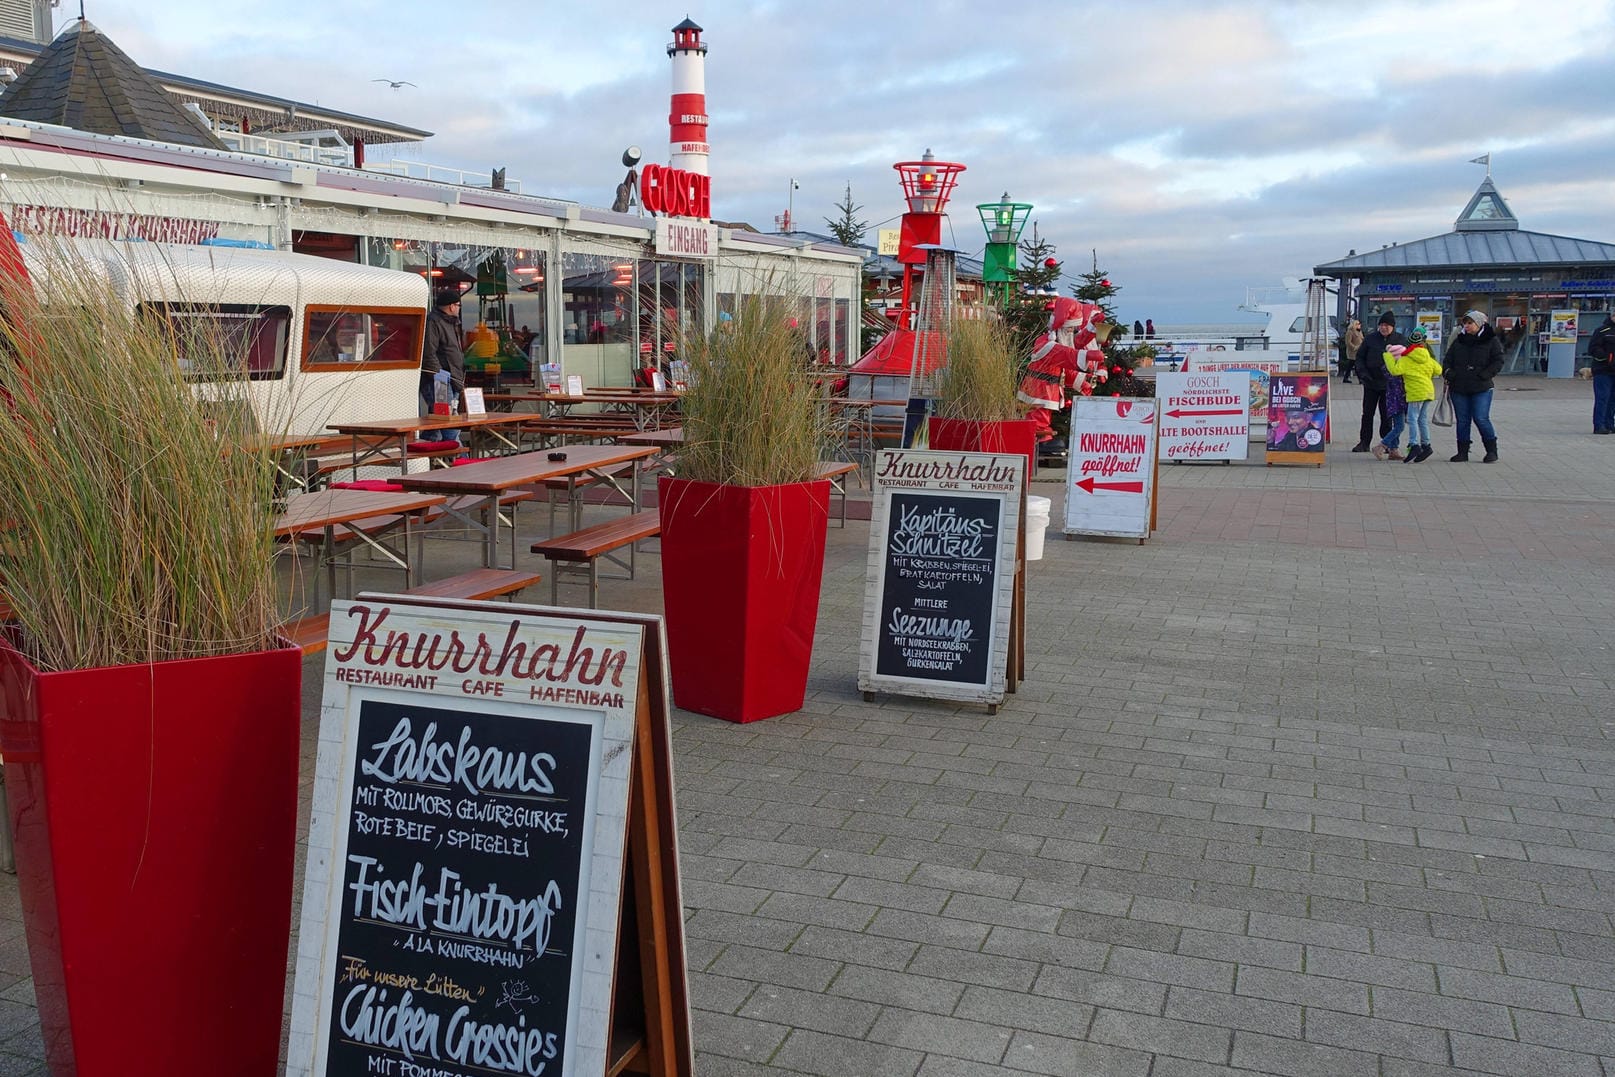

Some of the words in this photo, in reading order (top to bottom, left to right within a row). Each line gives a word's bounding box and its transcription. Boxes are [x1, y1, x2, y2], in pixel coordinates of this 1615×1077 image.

[640, 164, 712, 219] GOSCH
[11, 204, 123, 240] RESTAURANT
[667, 224, 708, 254] EINGANG
[1187, 376, 1220, 388] GOSCH
[1168, 395, 1241, 406] FISCHBUDE
[1181, 425, 1247, 437] BOOTSHALLE
[1080, 433, 1146, 454] KNURRHAHN
[1168, 441, 1230, 457] geöffnet!
[877, 452, 1016, 483] Knurrhahn
[1081, 454, 1142, 476] geöffnet!
[878, 478, 928, 488] RESTAURANT
[938, 481, 960, 489] CAFE
[971, 482, 1015, 491] HAFENBAR
[890, 530, 983, 557] Schnitzel
[917, 580, 947, 590] SALAT
[914, 598, 949, 609] MITTLERE
[888, 607, 974, 642] Seezunge
[334, 605, 628, 688] Knurrhahn
[894, 636, 907, 647] MIT
[908, 638, 971, 653] NORDSEEKRABBEN,
[907, 658, 954, 671] GURKENSALAT
[336, 667, 438, 691] RESTAURANT
[462, 679, 505, 697] CAFE
[530, 686, 624, 709] HAFENBAR
[361, 716, 556, 796] Labskaus
[354, 810, 393, 835] ROTE
[355, 784, 383, 806] MIT
[383, 788, 453, 819] ROLLMOPS,
[456, 798, 569, 839] GEWÜRZGURKE,
[348, 854, 562, 958] Fisch-Eintopf
[416, 937, 434, 954] LA
[374, 970, 423, 991] unsere
[340, 983, 440, 1061] Chicken
[445, 1004, 557, 1077] Crossies
[368, 1053, 396, 1076] MIT
